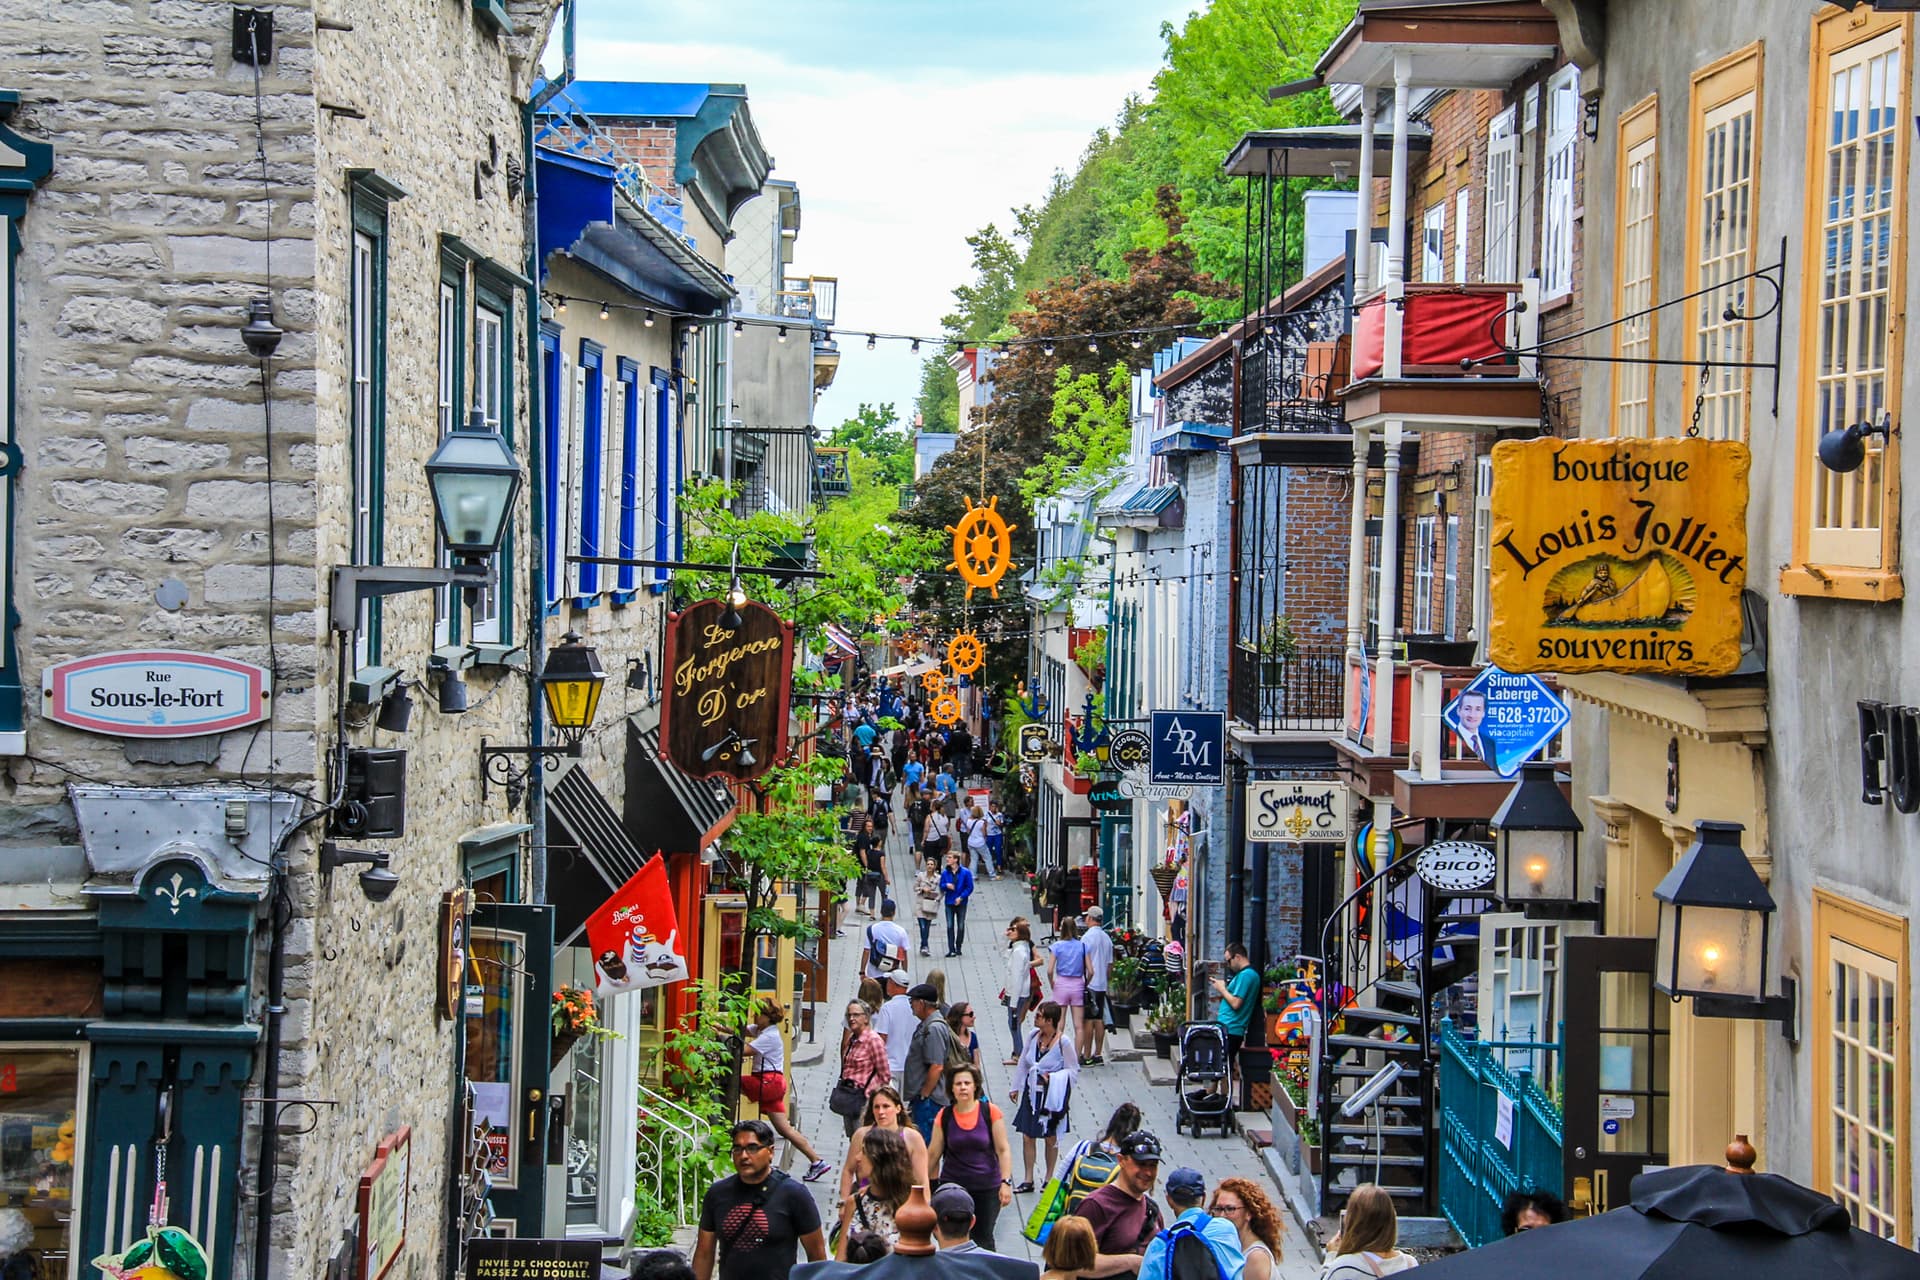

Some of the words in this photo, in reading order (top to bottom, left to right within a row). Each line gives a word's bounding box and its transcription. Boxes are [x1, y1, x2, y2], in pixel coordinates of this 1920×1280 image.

[1553, 444, 1689, 492] boutique
[1493, 509, 1617, 582] Louis
[1622, 498, 1746, 585] Jolliet
[1537, 631, 1694, 666] souvenirs
[675, 636, 781, 696] Forgeron
[145, 671, 171, 682] Rue
[1488, 673, 1528, 687] Simon
[90, 687, 224, 708] Sous-le-Fort
[1487, 688, 1539, 703] Laberge
[1498, 706, 1560, 723] 628-3720
[1309, 830, 1344, 838] SOUVENIRS
[1433, 861, 1481, 871] BICO
[479, 1259, 510, 1267] ENVIE
[513, 1260, 527, 1268] DE
[530, 1260, 590, 1269] CHOCOLAT?
[476, 1268, 518, 1277] PASSEZ
[522, 1269, 539, 1277] AU
[543, 1269, 591, 1279] DOUBLE.
